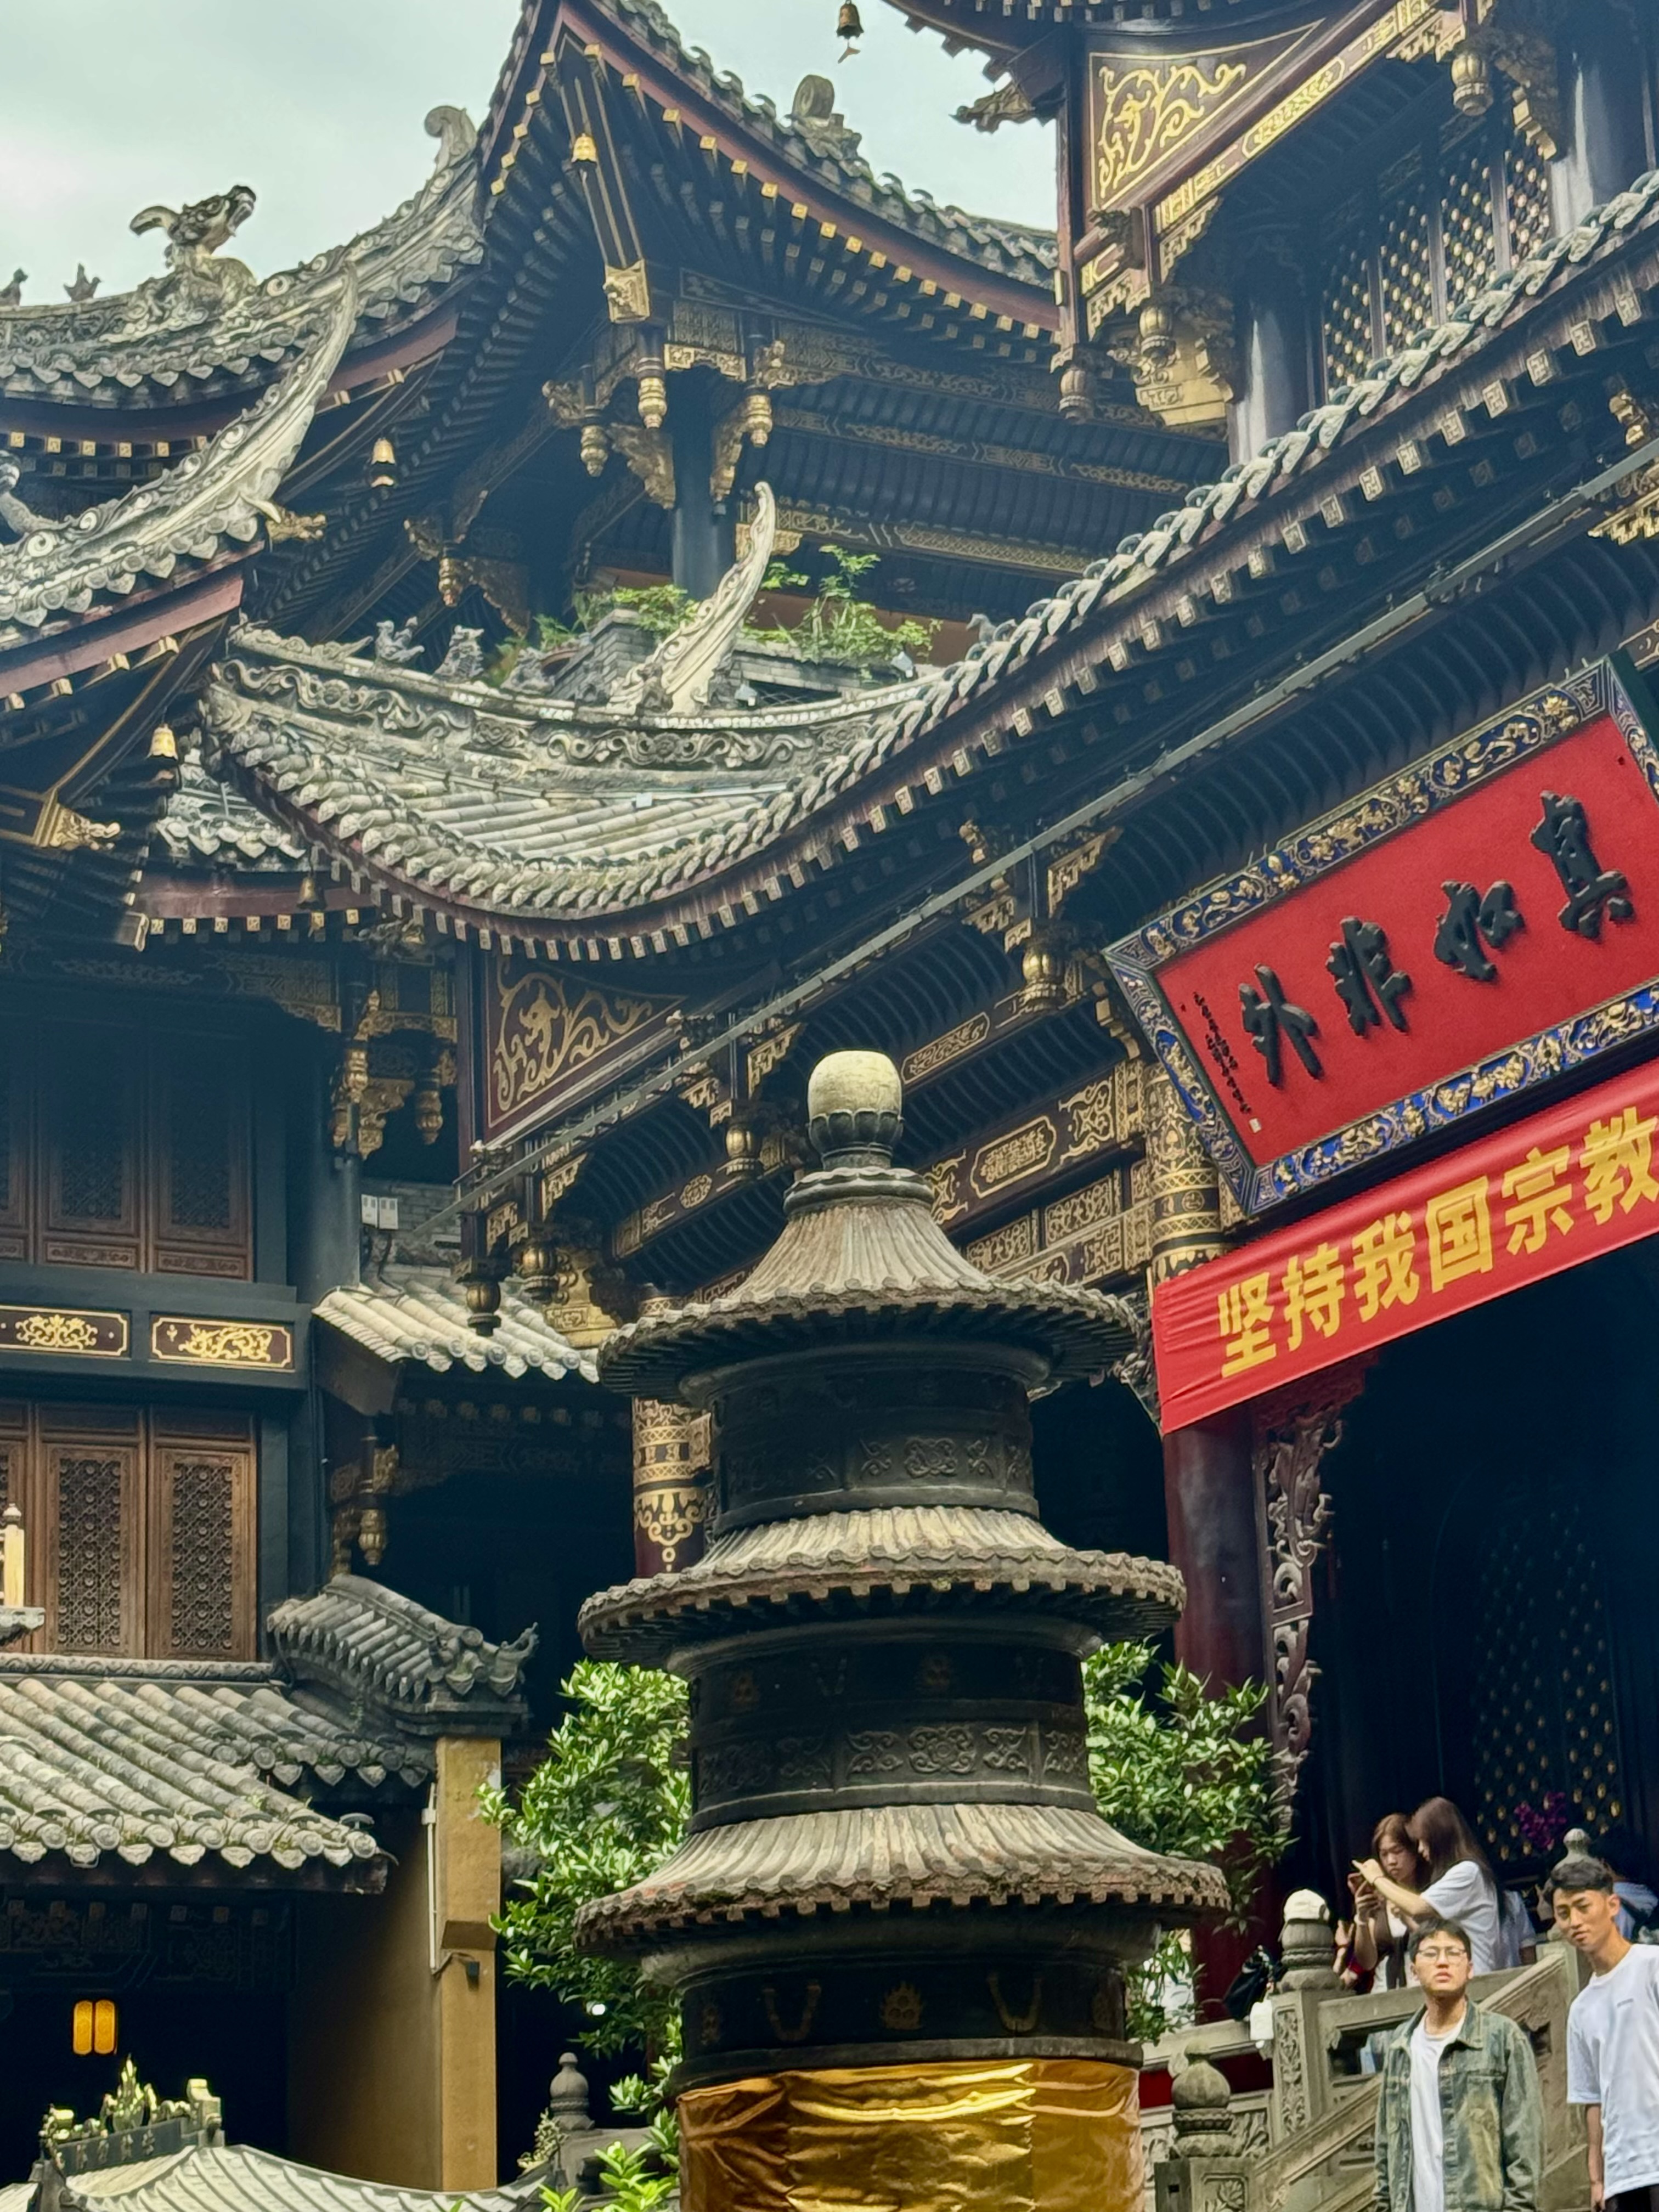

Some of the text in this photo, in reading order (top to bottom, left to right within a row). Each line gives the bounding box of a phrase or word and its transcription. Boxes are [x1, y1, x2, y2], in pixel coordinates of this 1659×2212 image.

[1217, 1107, 1659, 1379] 坚持我国宗教
